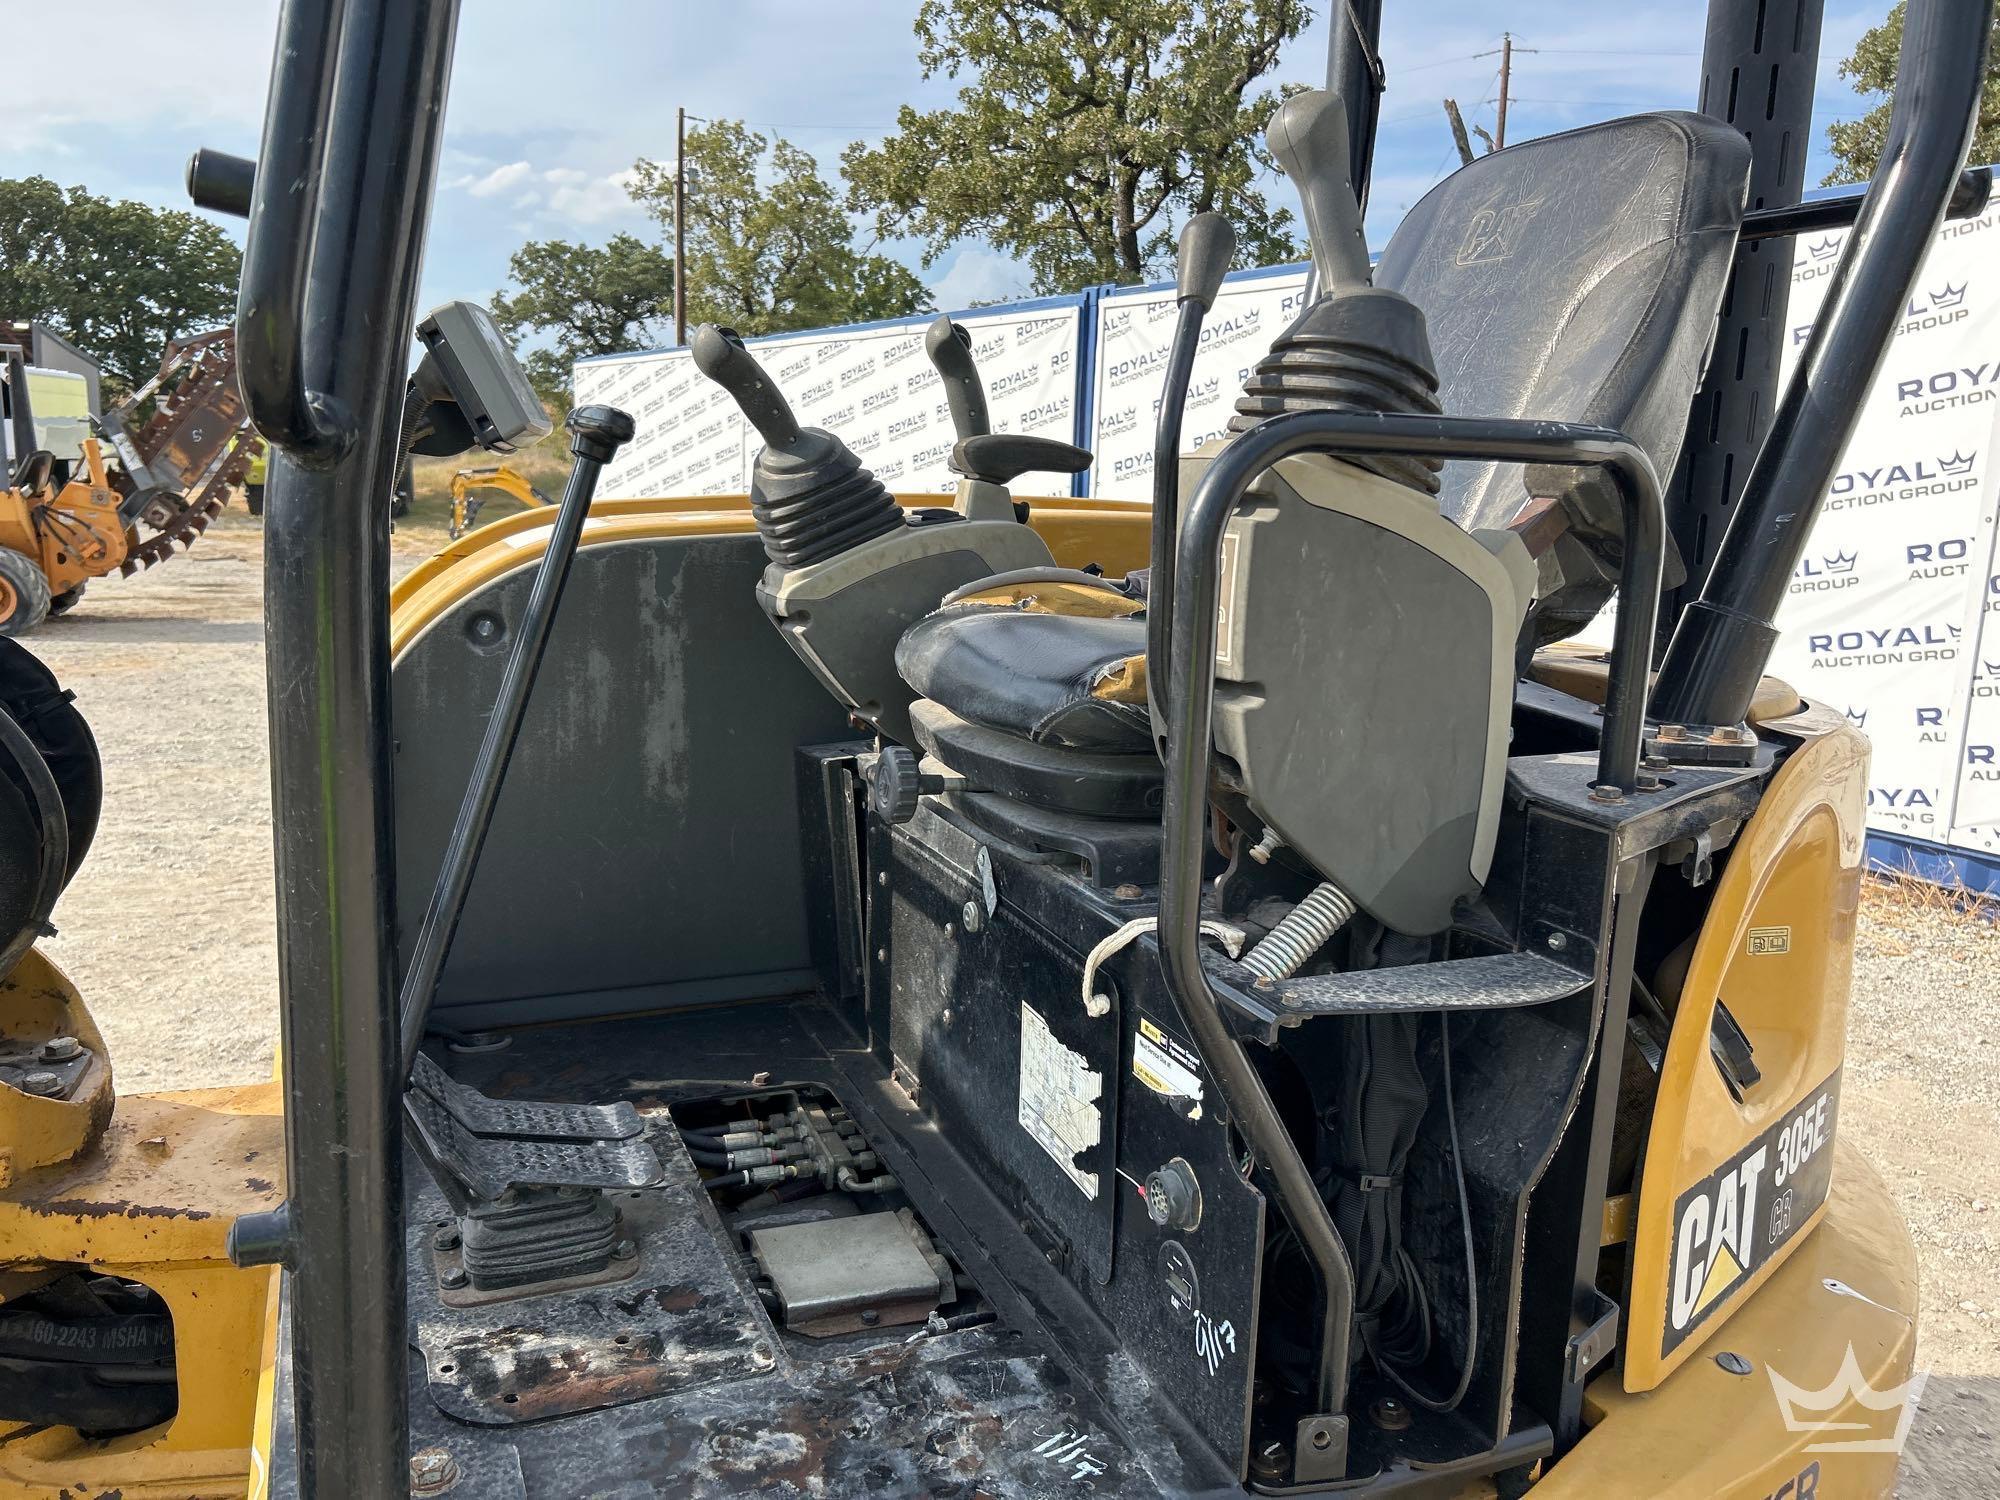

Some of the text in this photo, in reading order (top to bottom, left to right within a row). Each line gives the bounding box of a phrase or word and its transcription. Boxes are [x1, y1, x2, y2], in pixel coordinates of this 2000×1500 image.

[1228, 325, 1261, 343] GROUP
[883, 339, 913, 361] ROYAL
[1109, 351, 1157, 379] ROYAL
[991, 369, 1028, 393] ROYAL
[862, 389, 891, 408] ROYAL
[888, 416, 918, 434] ROYAL
[1021, 402, 1060, 425] ROYAL
[913, 445, 943, 464] ROYAL
[1900, 477, 1978, 500] GROUP
[1790, 576, 1859, 594] GROUP
[1809, 625, 1946, 653] ROYAL
[1811, 647, 1959, 669] AUCTION GRO
[1768, 1188, 1793, 1244] CR
[1671, 1144, 1767, 1330] CAT
[102, 1325, 147, 1349] MSHA
